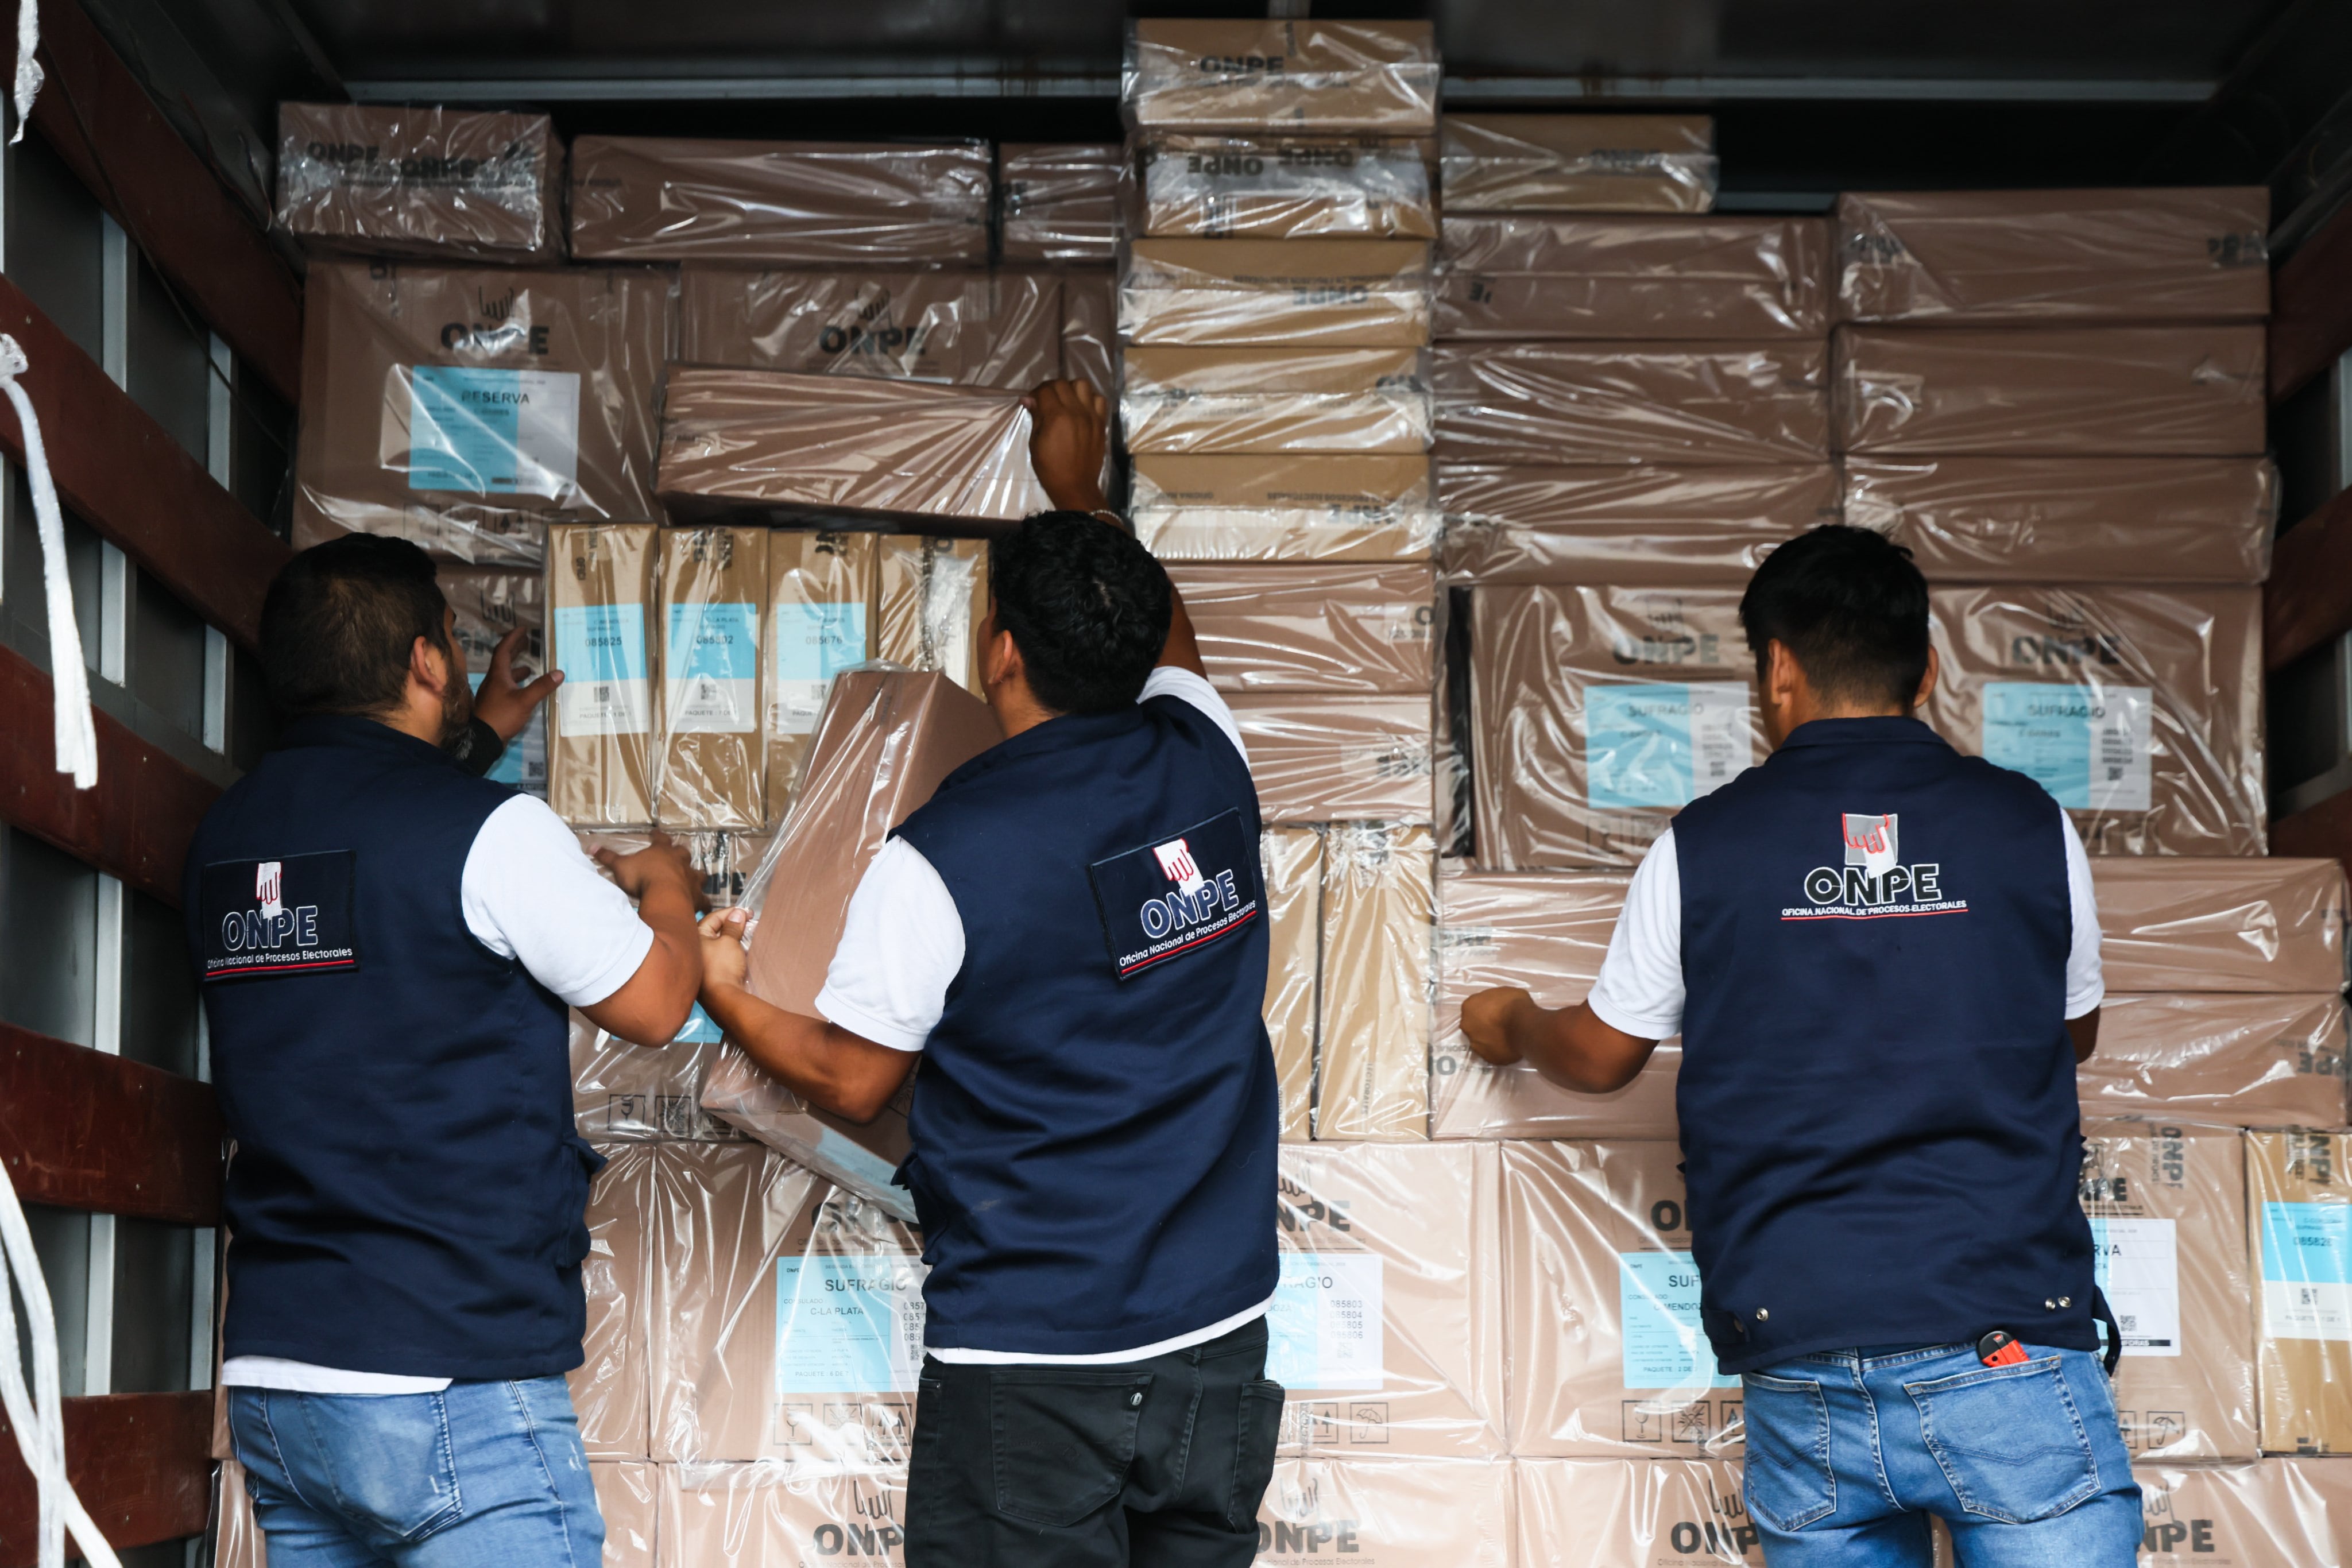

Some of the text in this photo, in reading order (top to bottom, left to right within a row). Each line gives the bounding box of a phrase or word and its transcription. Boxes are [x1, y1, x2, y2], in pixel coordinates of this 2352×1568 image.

[1187, 156, 1263, 176] ONPE
[440, 323, 550, 354] ONE
[461, 390, 529, 404] RESERVA
[585, 637, 622, 647] 085825
[697, 635, 734, 645] 085802
[805, 636, 843, 645] 085676
[2028, 704, 2106, 719] SUFRAGIO
[1804, 862, 1942, 906] ONPE
[1140, 869, 1240, 939] ONPE
[1782, 900, 1967, 916] OFICINA NACIONAL DE PROCESOS ELECTORALES
[222, 905, 318, 951] ONPE
[1120, 900, 1256, 967] Oficina Nacional de Procesos Electorales
[225, 954, 254, 965] Nacional
[256, 953, 264, 963] de
[265, 951, 300, 962] Procesos
[303, 947, 353, 959] Electorales
[825, 1279, 907, 1292] SUFRAGIO
[810, 1307, 864, 1315] C-LA PLATA
[1330, 1300, 1363, 1308] 085803
[1329, 1310, 1363, 1319] 085804
